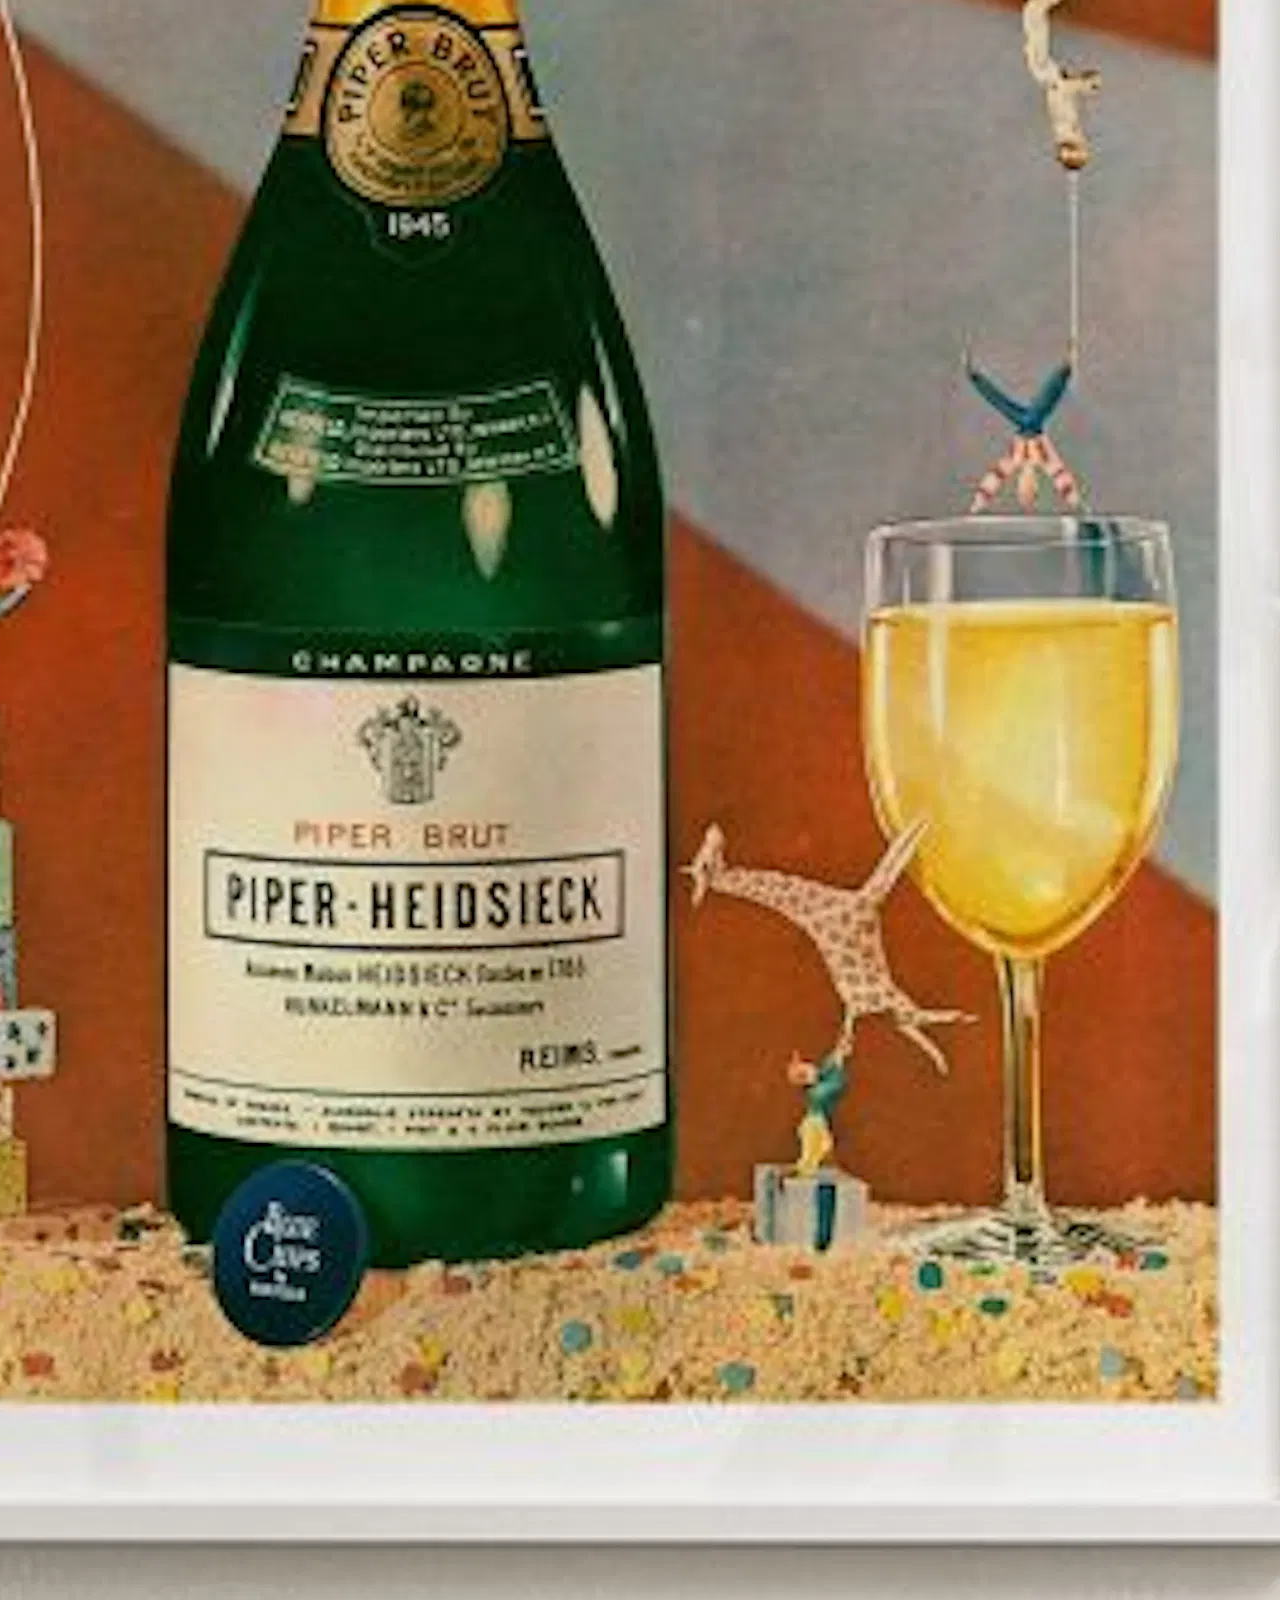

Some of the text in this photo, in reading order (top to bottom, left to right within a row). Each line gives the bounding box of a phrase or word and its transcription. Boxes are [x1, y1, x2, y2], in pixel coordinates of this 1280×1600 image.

[337, 28, 498, 124] PIPER BRUT
[387, 211, 451, 237] 1945
[292, 650, 533, 674] CHAMPAGNE
[294, 822, 511, 848] PIPER BRUT
